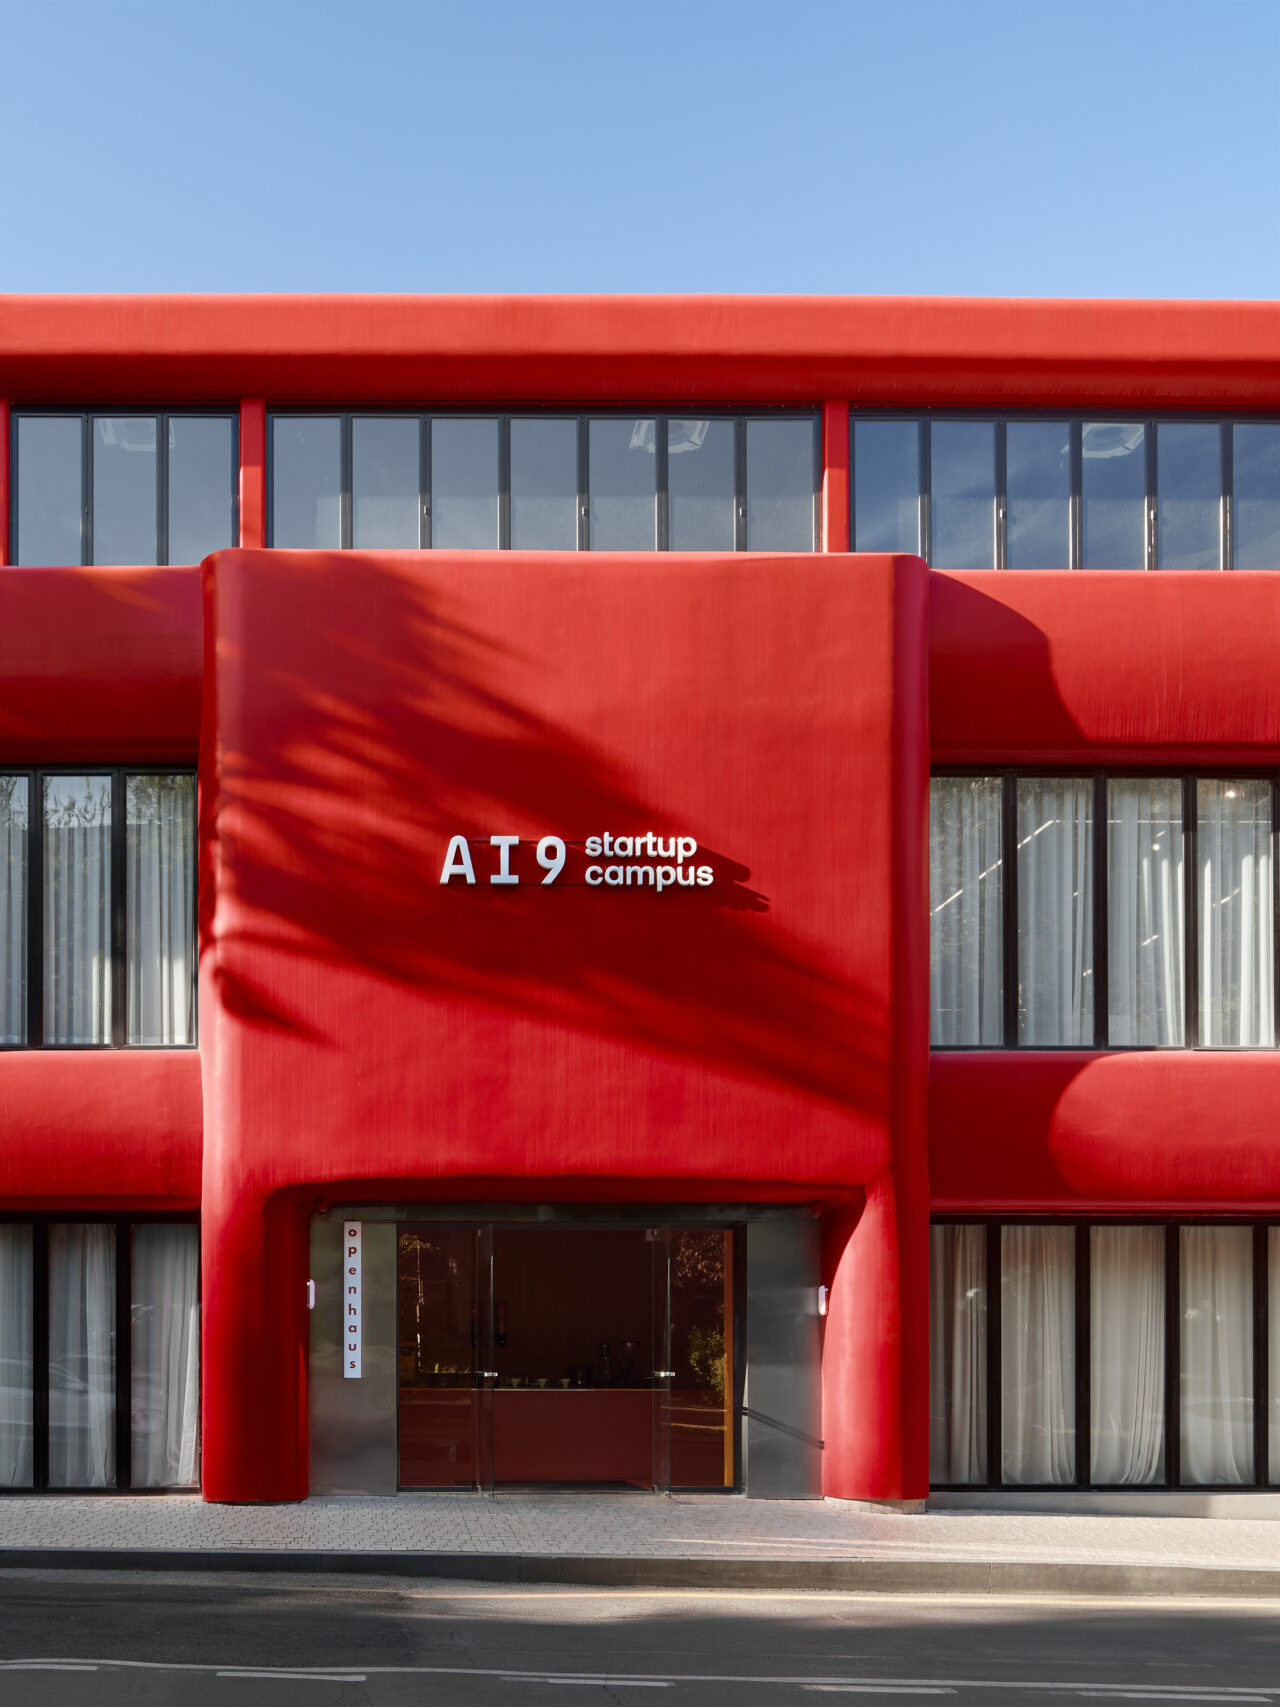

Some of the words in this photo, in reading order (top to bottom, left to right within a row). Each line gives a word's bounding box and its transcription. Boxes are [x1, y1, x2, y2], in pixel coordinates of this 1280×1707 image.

[439, 834, 567, 885] AI9
[584, 831, 698, 864] startup
[584, 864, 714, 892] campus
[347, 1228, 358, 1369] openhaus
